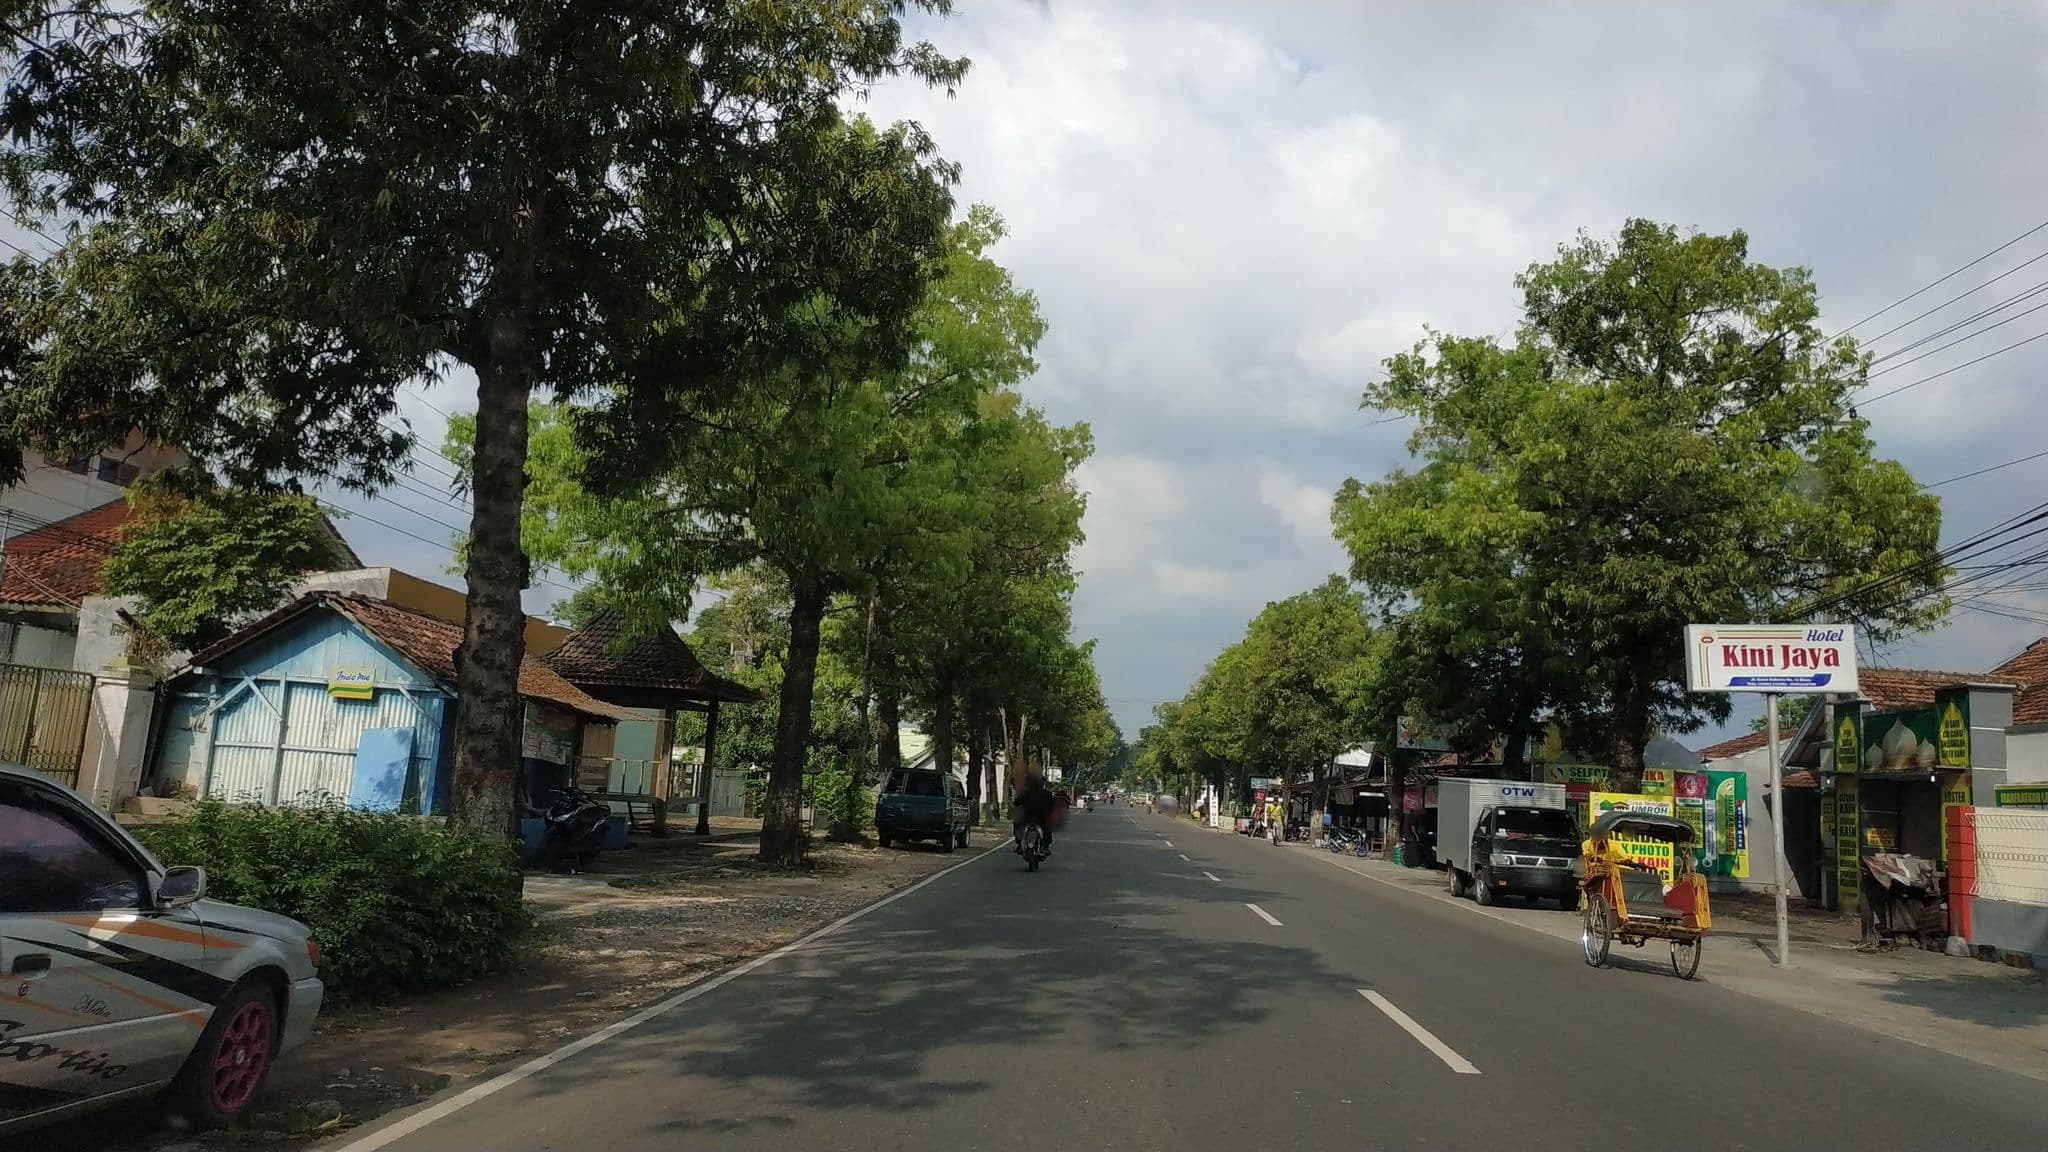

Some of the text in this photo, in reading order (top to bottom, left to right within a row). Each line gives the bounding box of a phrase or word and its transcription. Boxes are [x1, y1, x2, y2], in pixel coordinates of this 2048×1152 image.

[1807, 629, 1844, 642] Hotel
[1722, 645, 1840, 670] Kini Jaya
[1569, 767, 1608, 778] SELECT
[1502, 787, 1535, 797] OTW
[1632, 805, 1668, 815] UMROH
[1631, 844, 1669, 857] PHOTO
